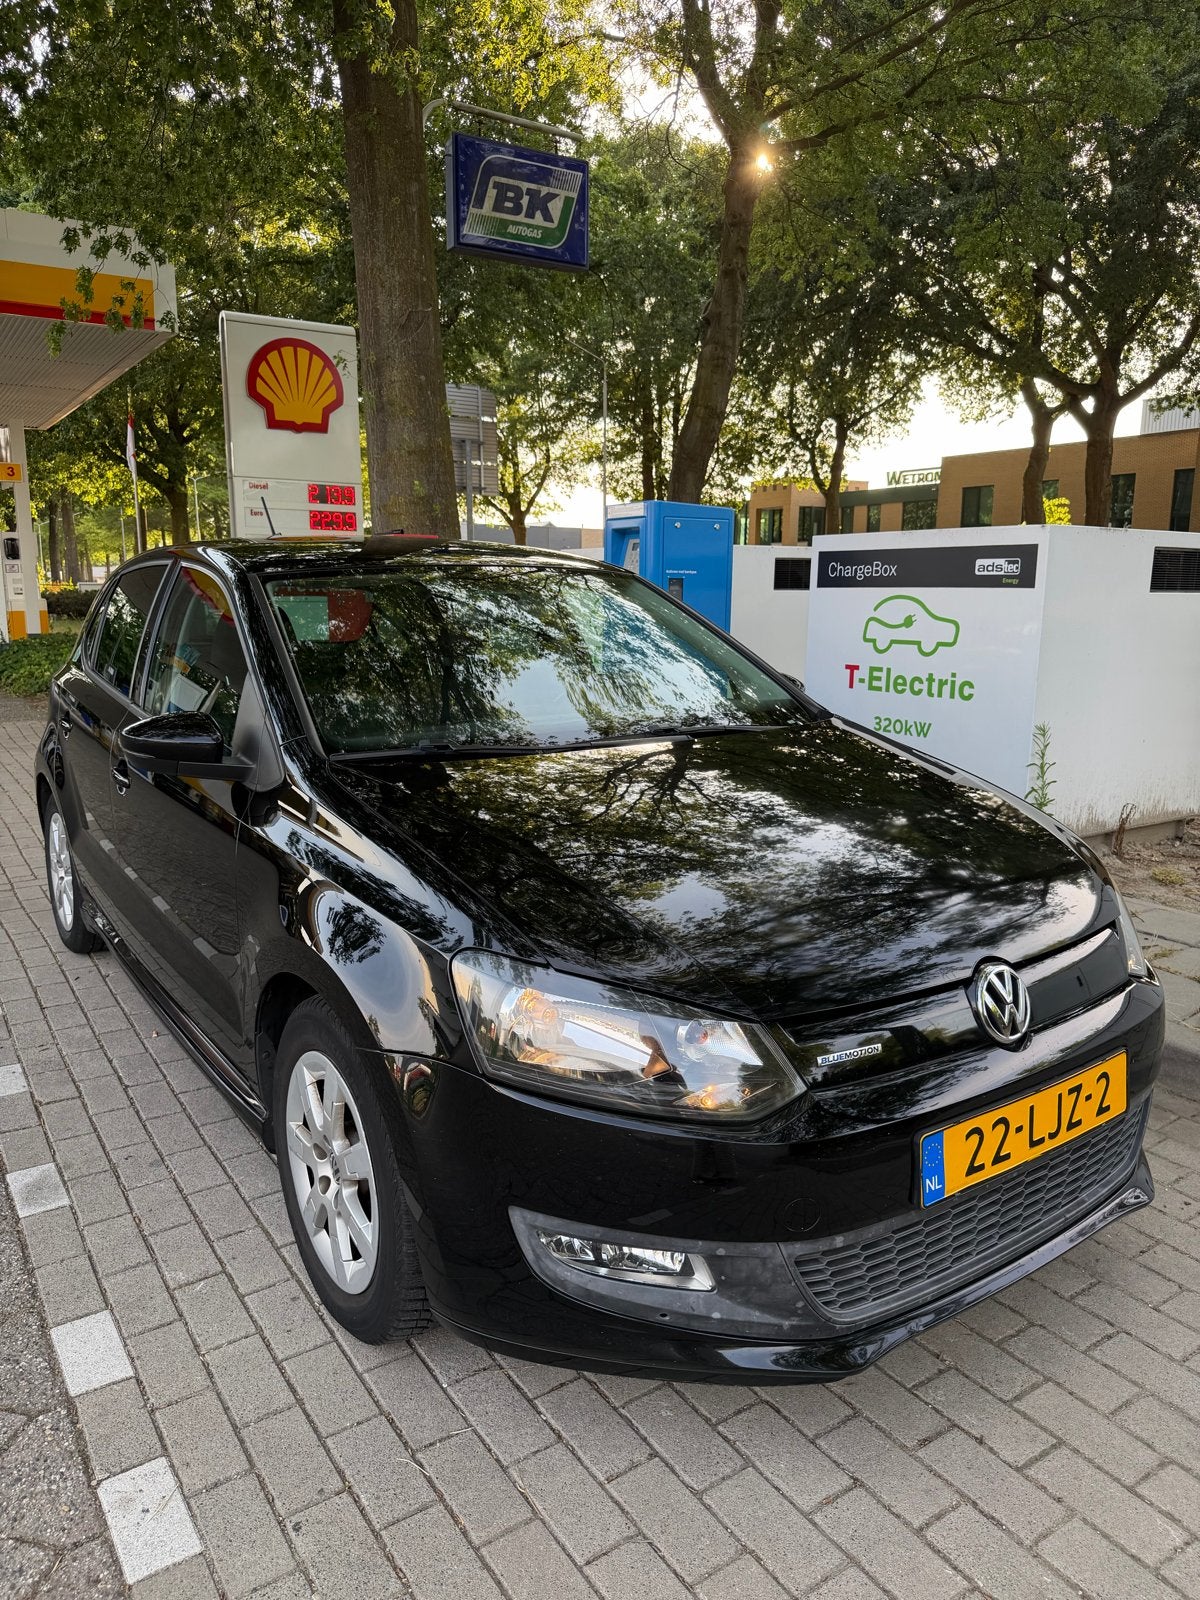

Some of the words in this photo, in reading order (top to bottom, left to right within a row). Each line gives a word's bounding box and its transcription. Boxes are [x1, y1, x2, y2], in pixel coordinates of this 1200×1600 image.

[492, 181, 560, 224] BK
[506, 224, 543, 238] AUTOGAS
[6, 466, 16, 477] 3
[248, 481, 269, 490] Diesel
[250, 509, 264, 517] Euro
[828, 561, 898, 581] ChargeBox
[1002, 577, 1020, 585] Energy
[844, 664, 976, 702] T-Electric
[873, 716, 933, 739] 320kW
[820, 1045, 880, 1065] BLUEMOTION
[925, 1174, 943, 1194] NL
[964, 1071, 1111, 1178] 22-LJZ-2
